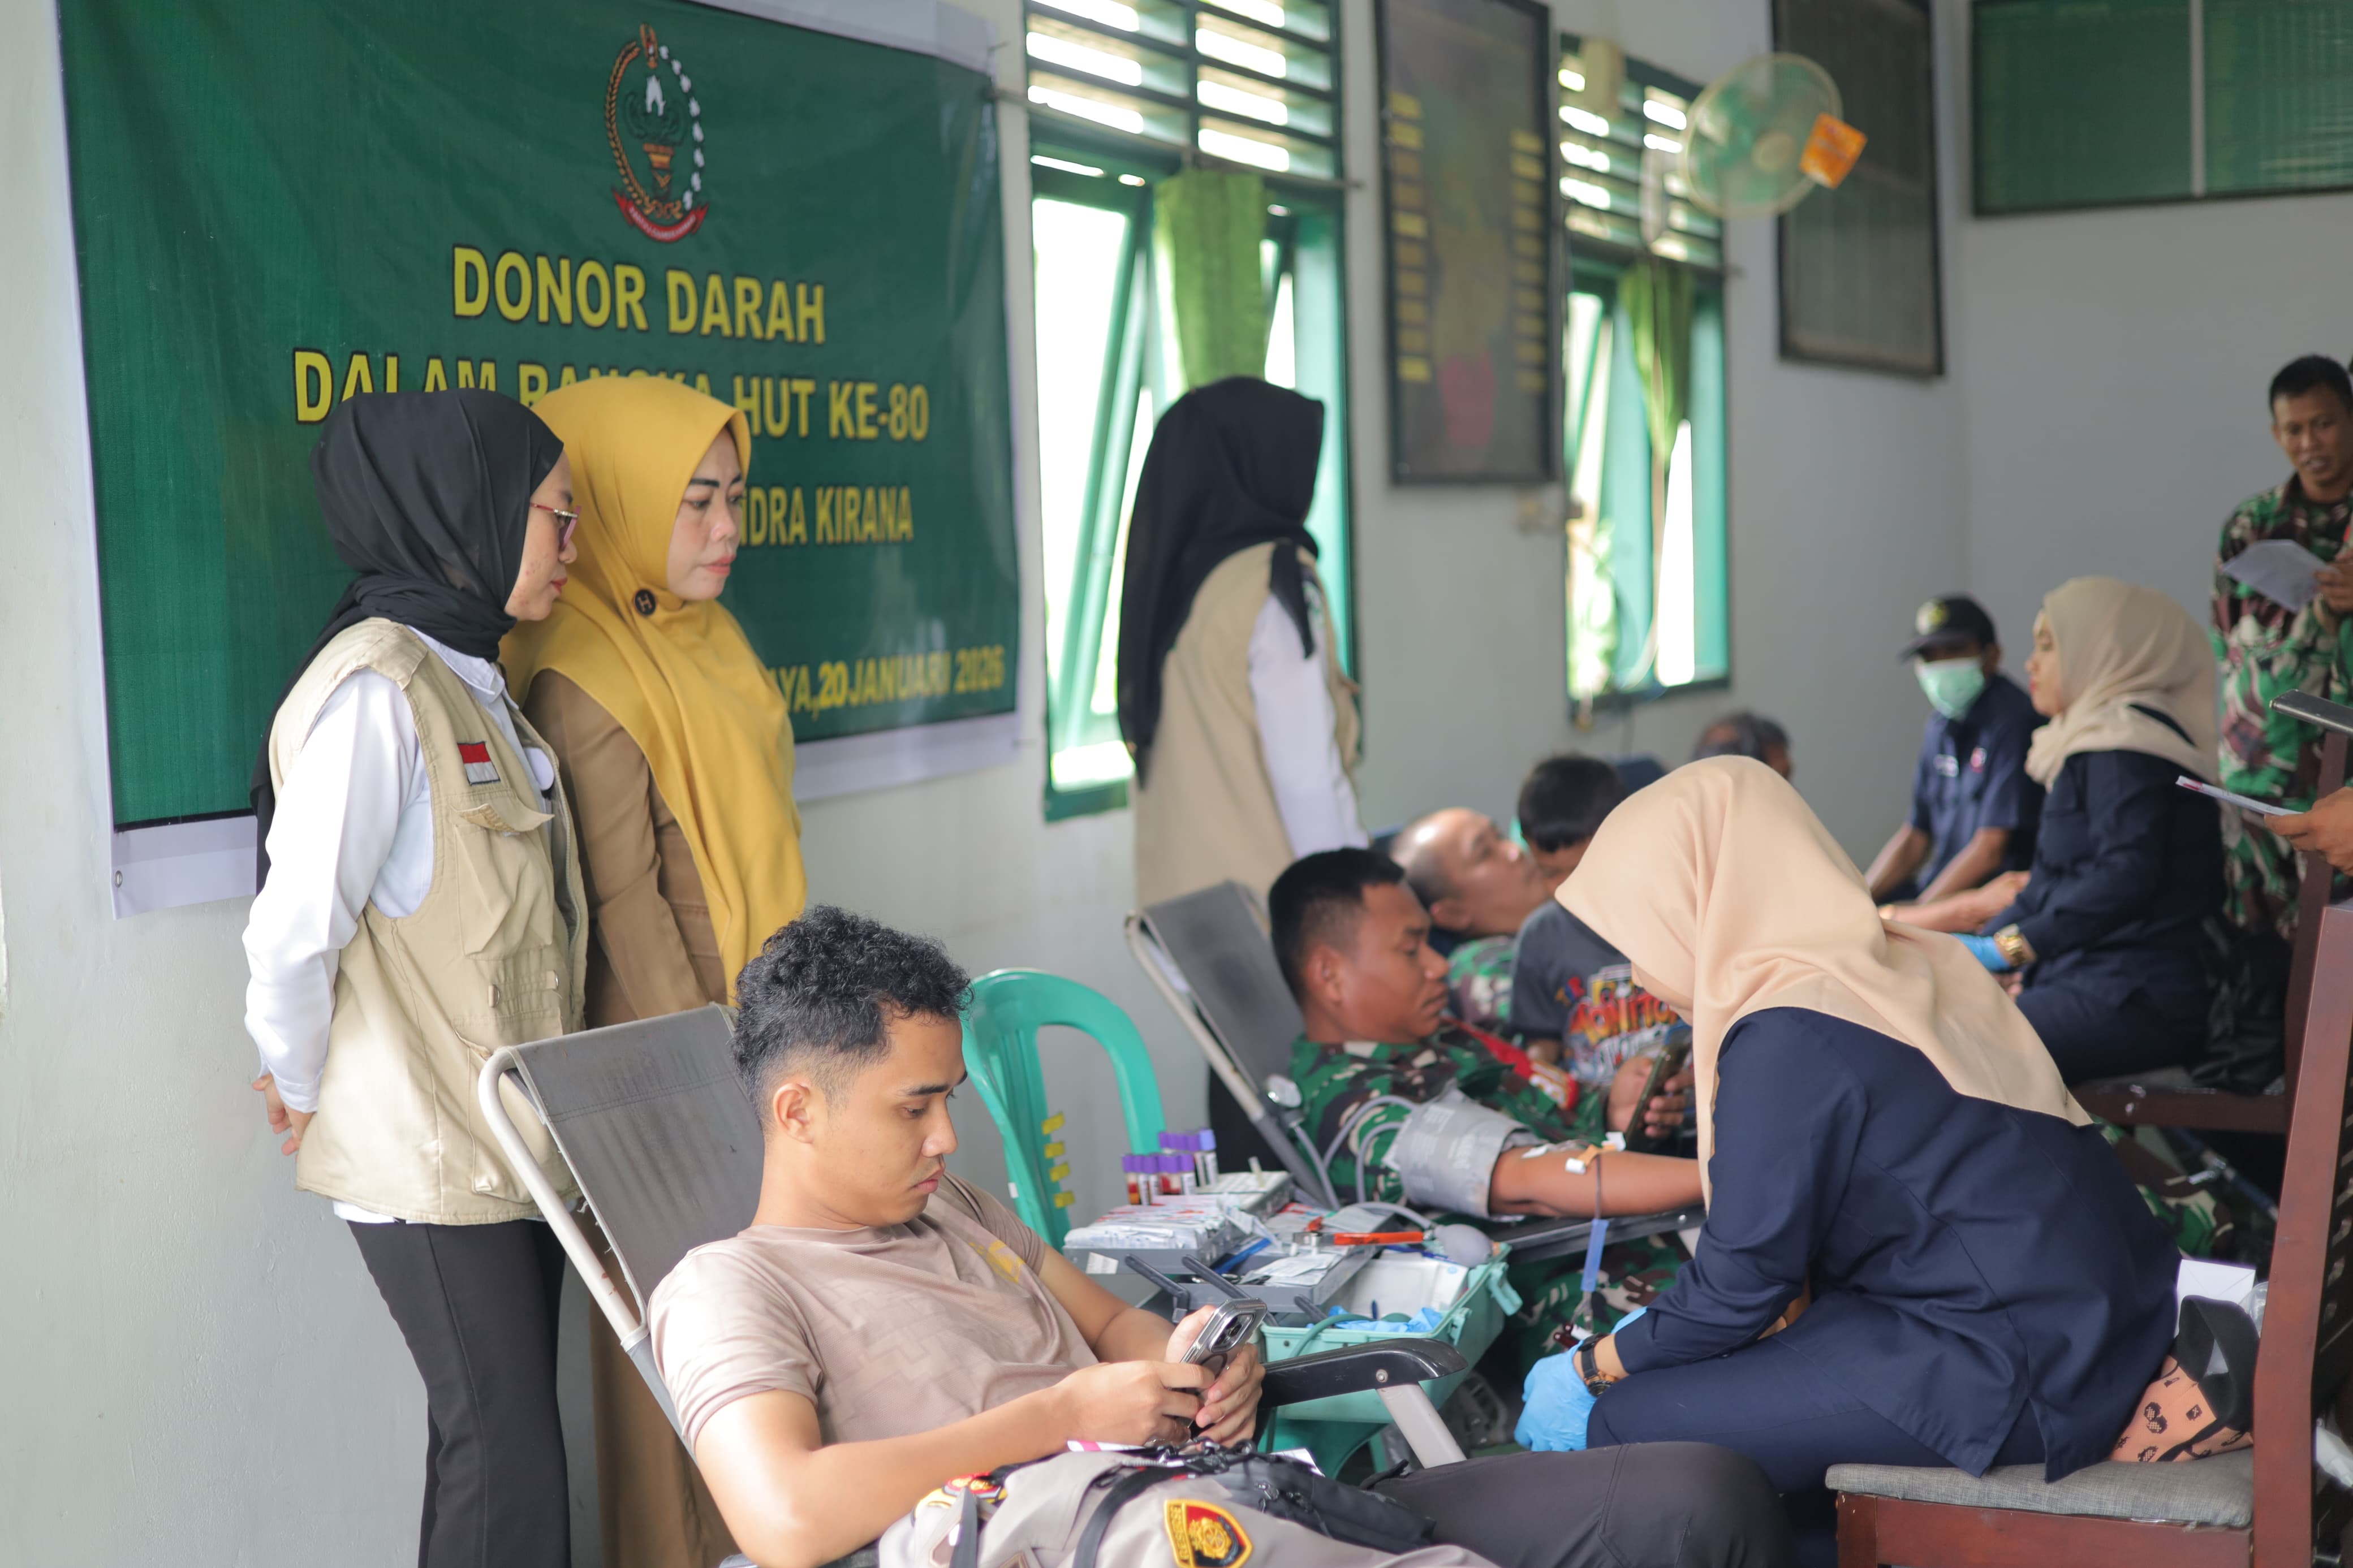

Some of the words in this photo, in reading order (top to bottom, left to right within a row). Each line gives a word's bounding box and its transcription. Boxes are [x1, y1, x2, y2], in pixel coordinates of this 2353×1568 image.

[454, 247, 649, 331] DONOR
[666, 269, 826, 344] DARAH
[733, 374, 816, 438] HUT
[829, 379, 929, 442] KE-80
[815, 485, 914, 545] KIRANA
